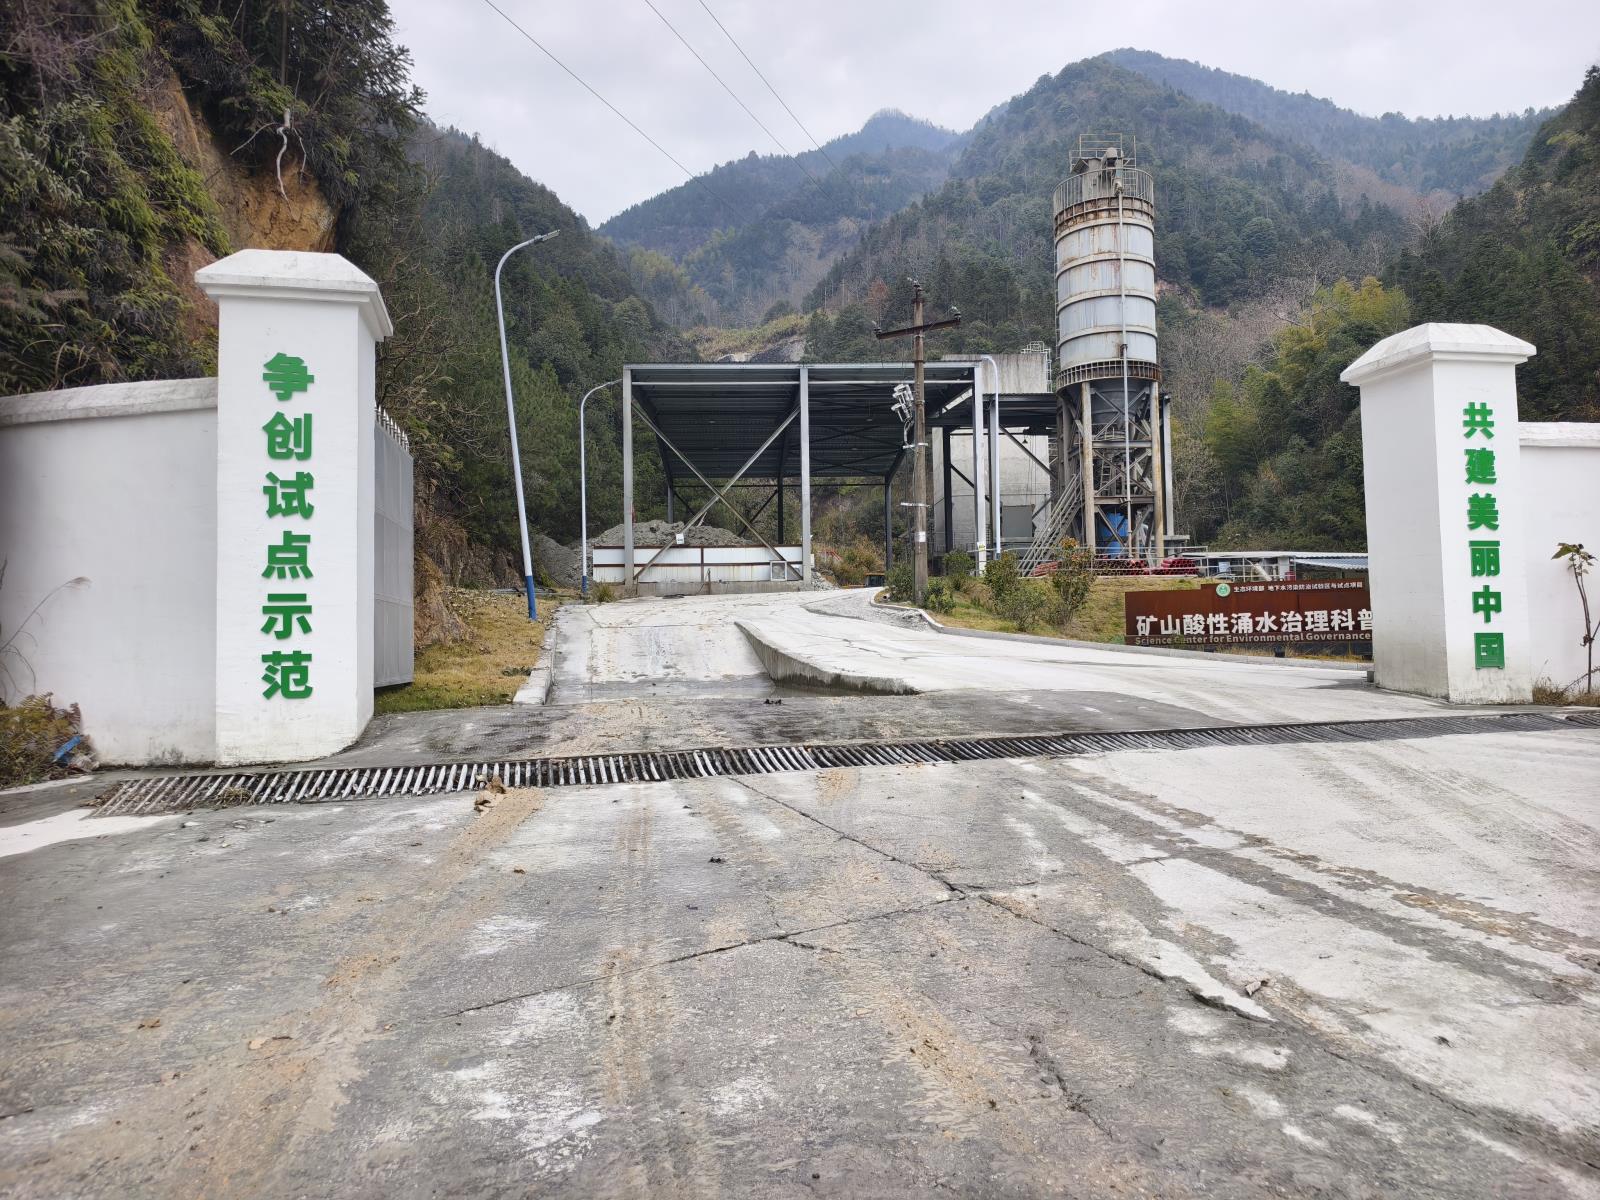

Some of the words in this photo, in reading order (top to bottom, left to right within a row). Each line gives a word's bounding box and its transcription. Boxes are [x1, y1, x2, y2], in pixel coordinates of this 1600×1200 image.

[261, 352, 315, 699] 争创试点示范
[1463, 402, 1505, 669] 共建美丽中国
[1233, 585, 1265, 593] 生态环境部
[1136, 608, 1374, 636] 矿山酸性涌水治理科普
[1135, 636, 1172, 646] Science
[1210, 633, 1225, 643] for
[1226, 633, 1304, 643] Environmental
[1306, 632, 1371, 640] Governance
